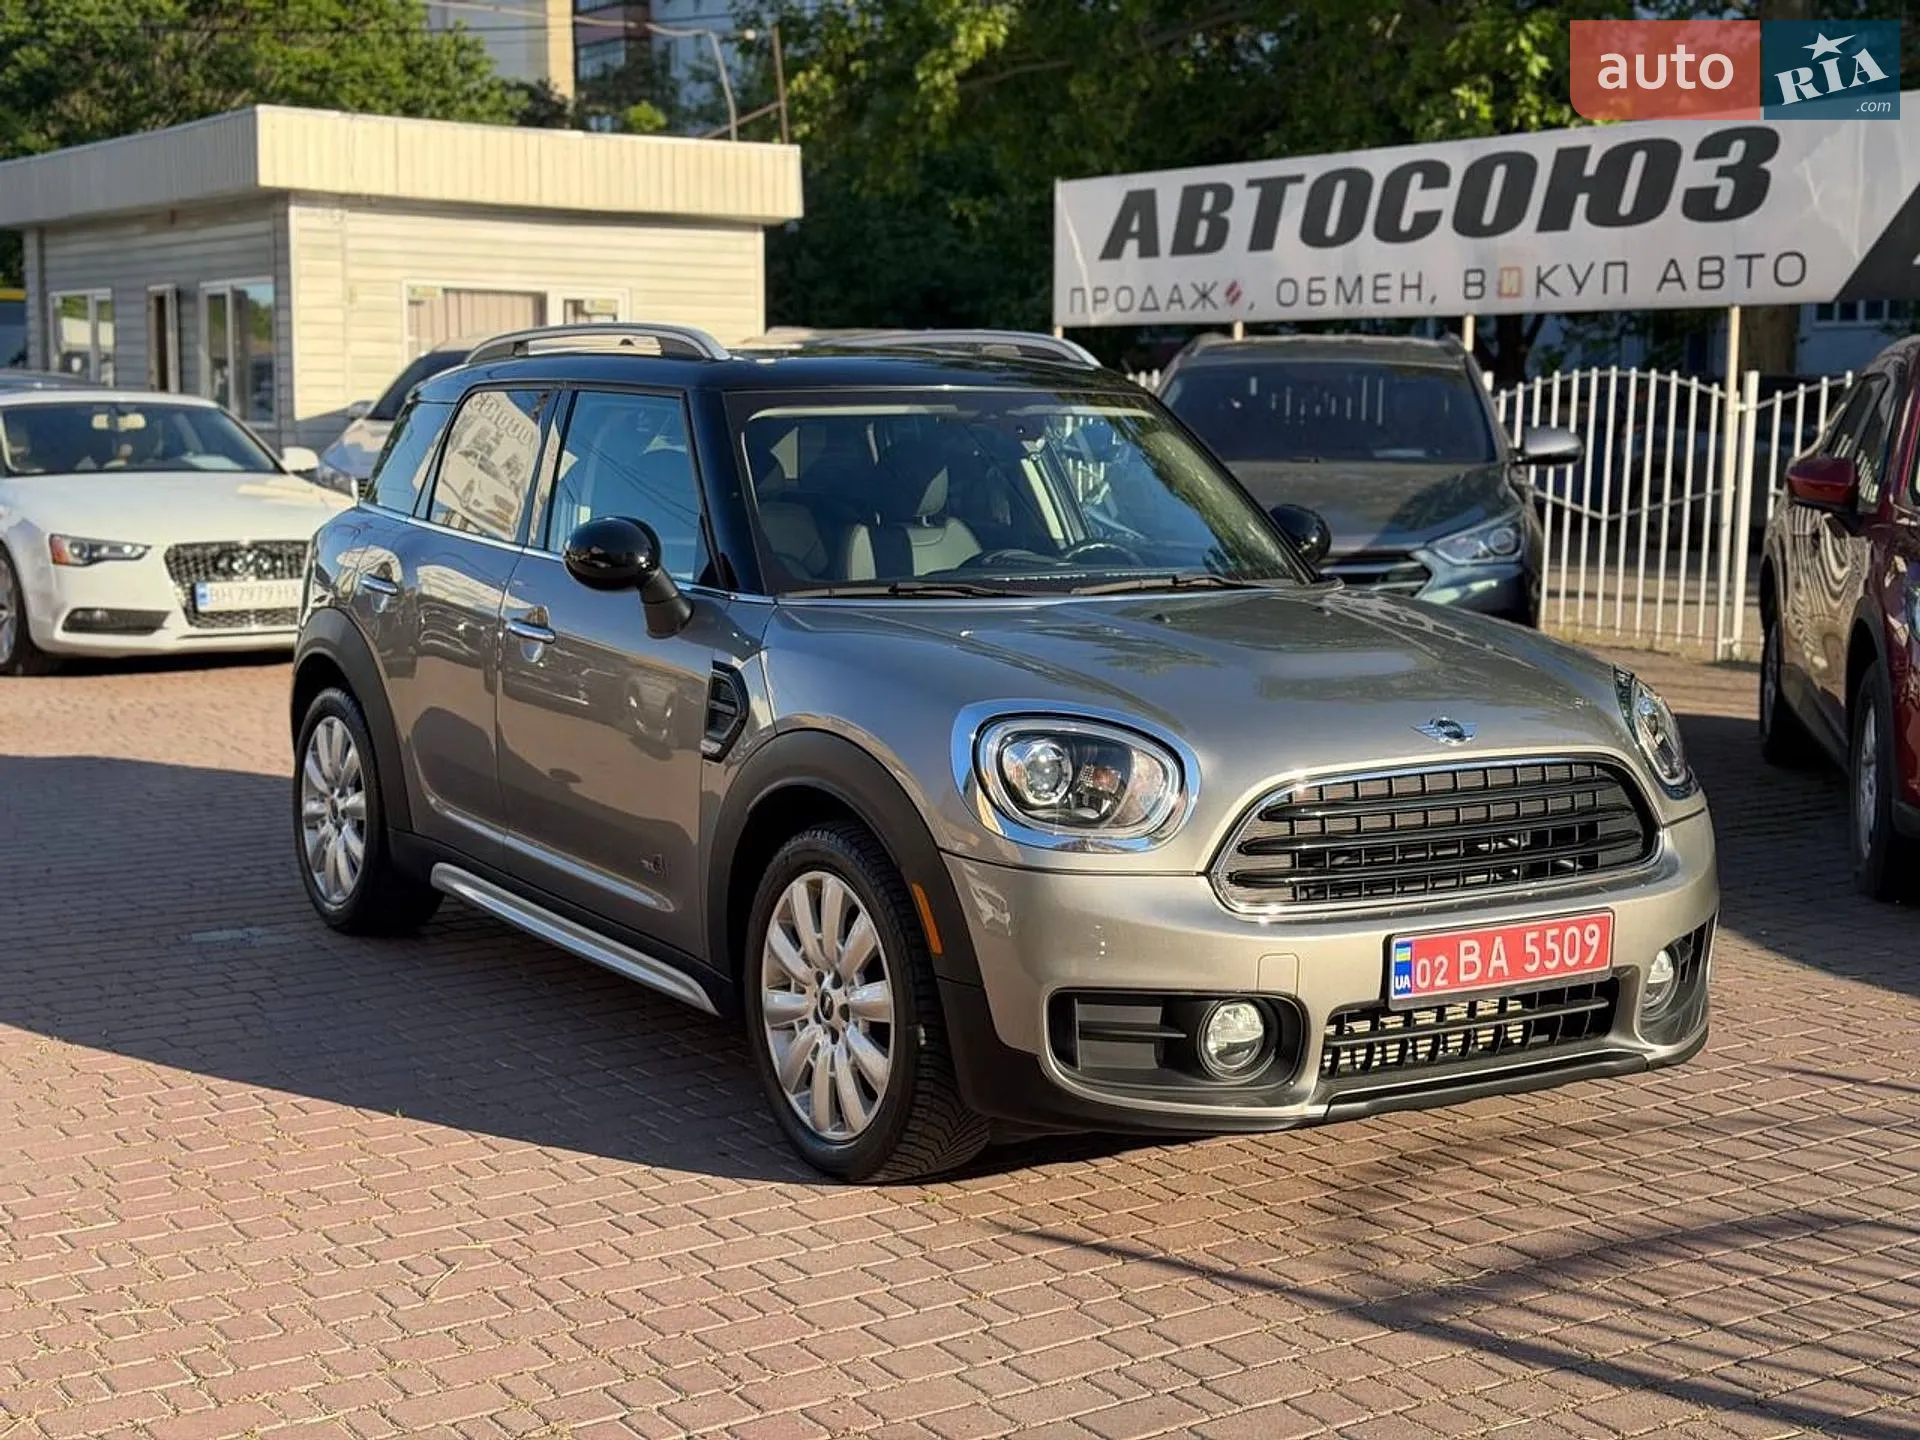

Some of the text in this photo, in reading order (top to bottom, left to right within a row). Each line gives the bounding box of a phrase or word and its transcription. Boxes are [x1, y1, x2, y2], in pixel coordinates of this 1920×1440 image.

[1099, 126, 1780, 261] АВТОСОЮЗ
[1069, 279, 1255, 314] ПРОДАЖ,
[1275, 271, 1438, 308] ОБМЕН,
[1656, 251, 1807, 292] АВТО
[1394, 973, 1412, 990] UA
[1416, 923, 1601, 989] 02 BA 5509
